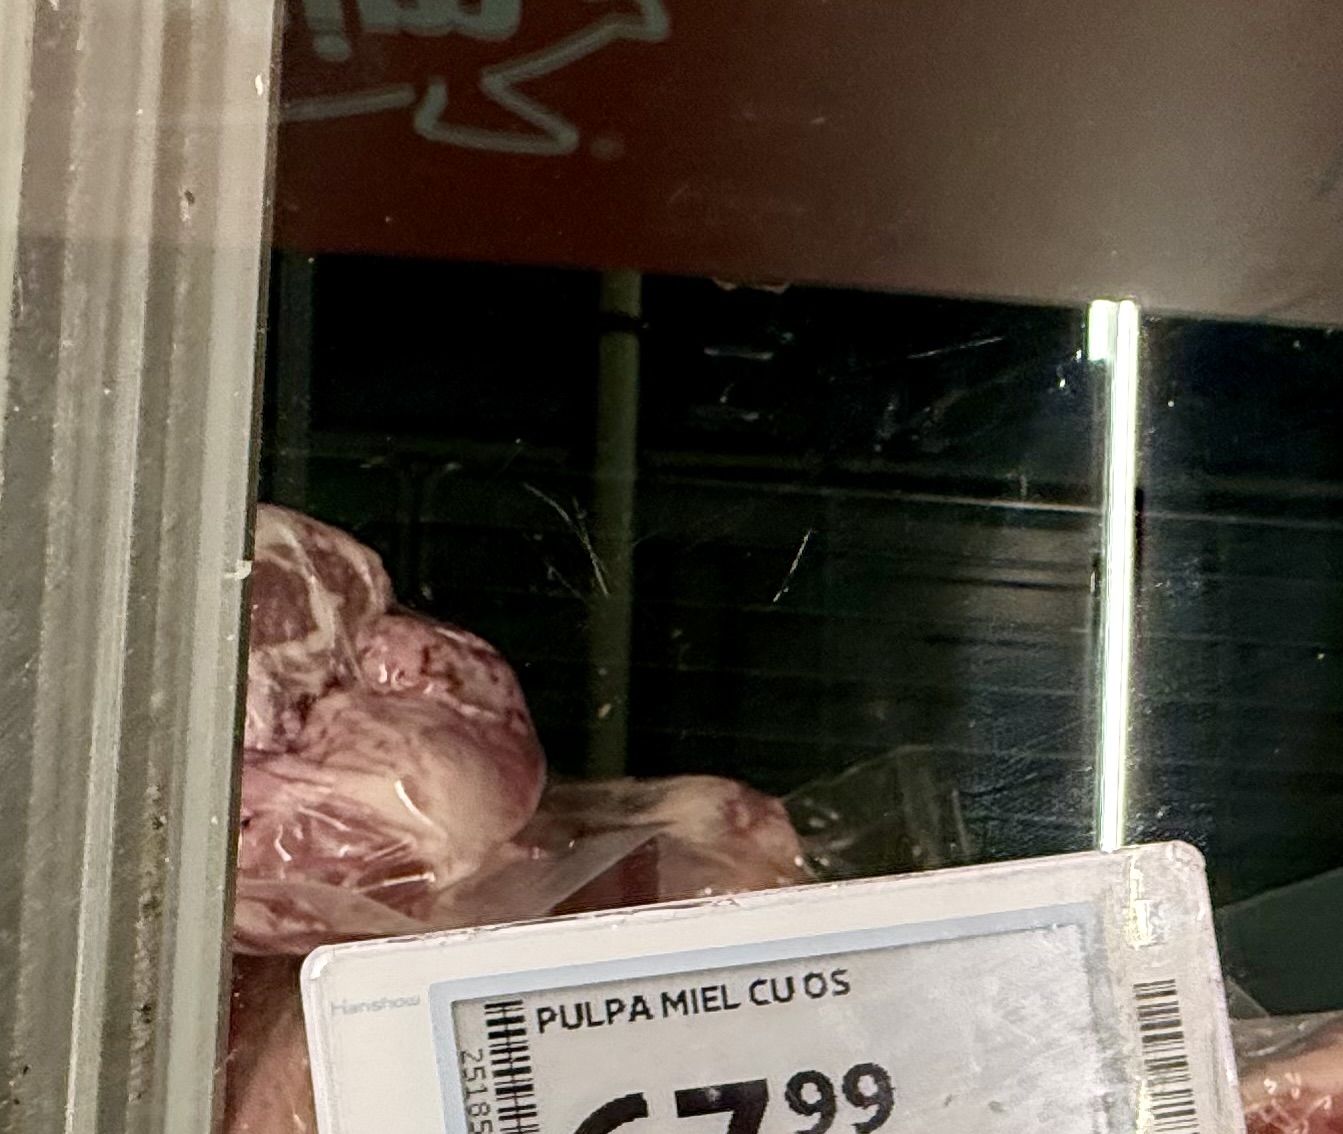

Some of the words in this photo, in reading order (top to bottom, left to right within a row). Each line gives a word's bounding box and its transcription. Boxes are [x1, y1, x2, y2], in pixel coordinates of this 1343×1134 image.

[330, 995, 421, 1017] Hanshow
[536, 996, 656, 1034] PULPA
[660, 984, 741, 1018] MIEL
[748, 976, 796, 1007] CU
[804, 968, 851, 1000] OS
